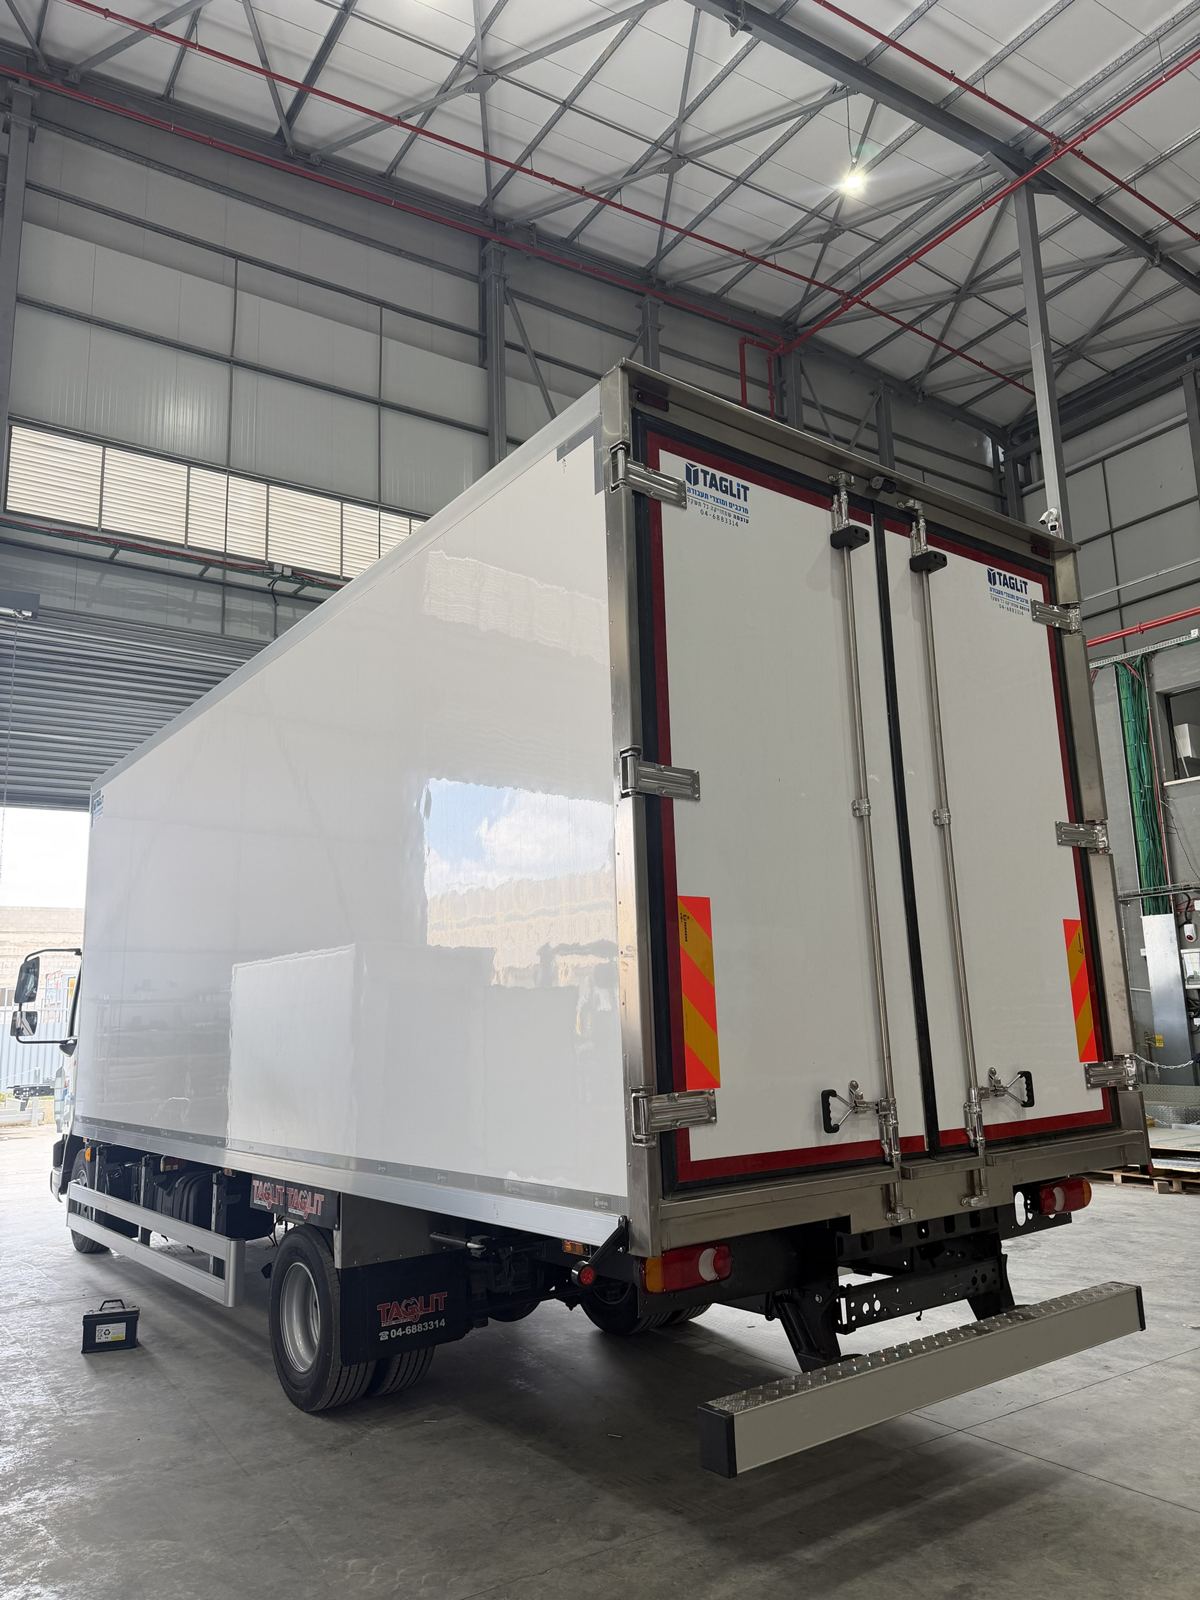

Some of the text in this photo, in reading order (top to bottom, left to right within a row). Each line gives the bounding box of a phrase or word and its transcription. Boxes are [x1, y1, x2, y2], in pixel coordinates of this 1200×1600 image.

[687, 487, 749, 514] מרכבים ומוצרי תעבורה
[700, 508, 739, 528] 04-6883314
[252, 1179, 325, 1220] TAGLIT TAGLIT
[377, 1291, 448, 1323] TAGLIT
[390, 1318, 446, 1339] 04-6883314
